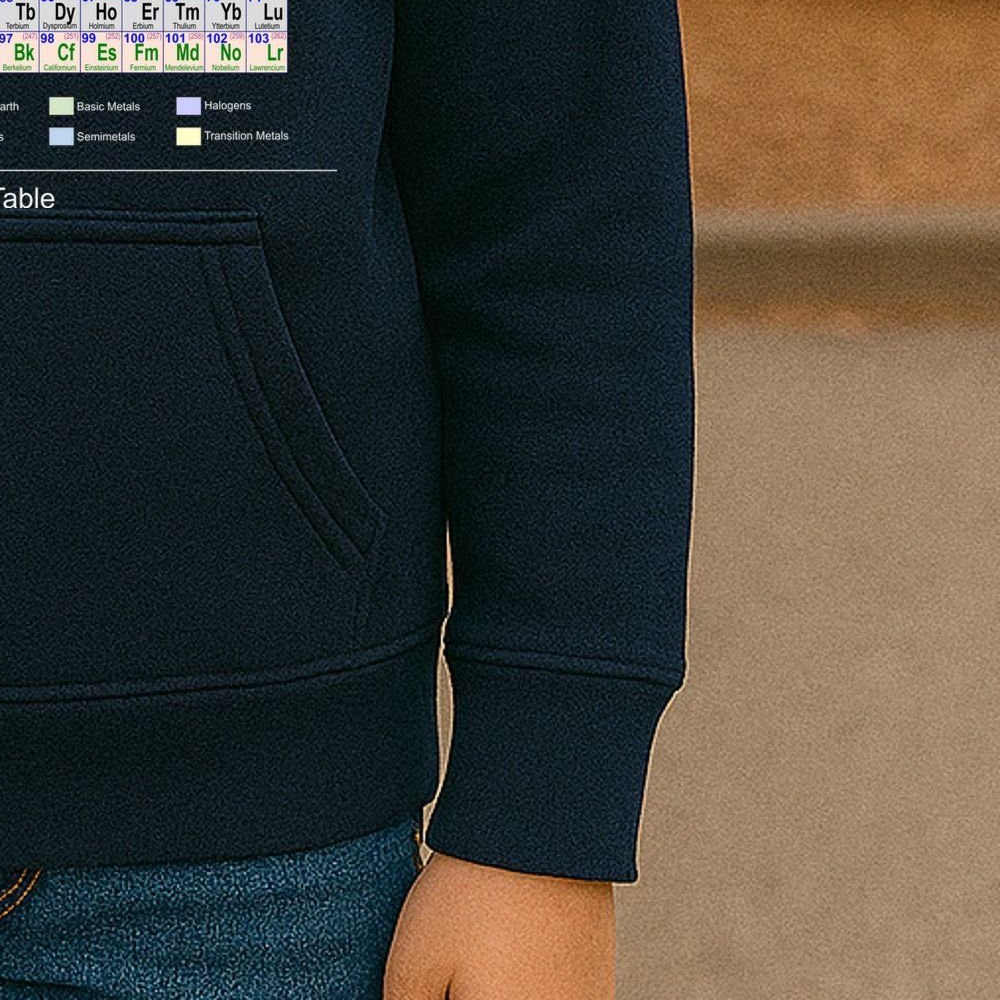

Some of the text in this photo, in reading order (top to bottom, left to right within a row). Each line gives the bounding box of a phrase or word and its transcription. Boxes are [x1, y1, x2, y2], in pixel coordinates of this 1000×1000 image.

[81, 33, 96, 44] 99
[97, 43, 117, 61] Es
[77, 102, 140, 111] Basic Metals
[205, 101, 251, 112] Halogens
[77, 132, 135, 142] Semimetals
[204, 131, 289, 140] Transition Metals
